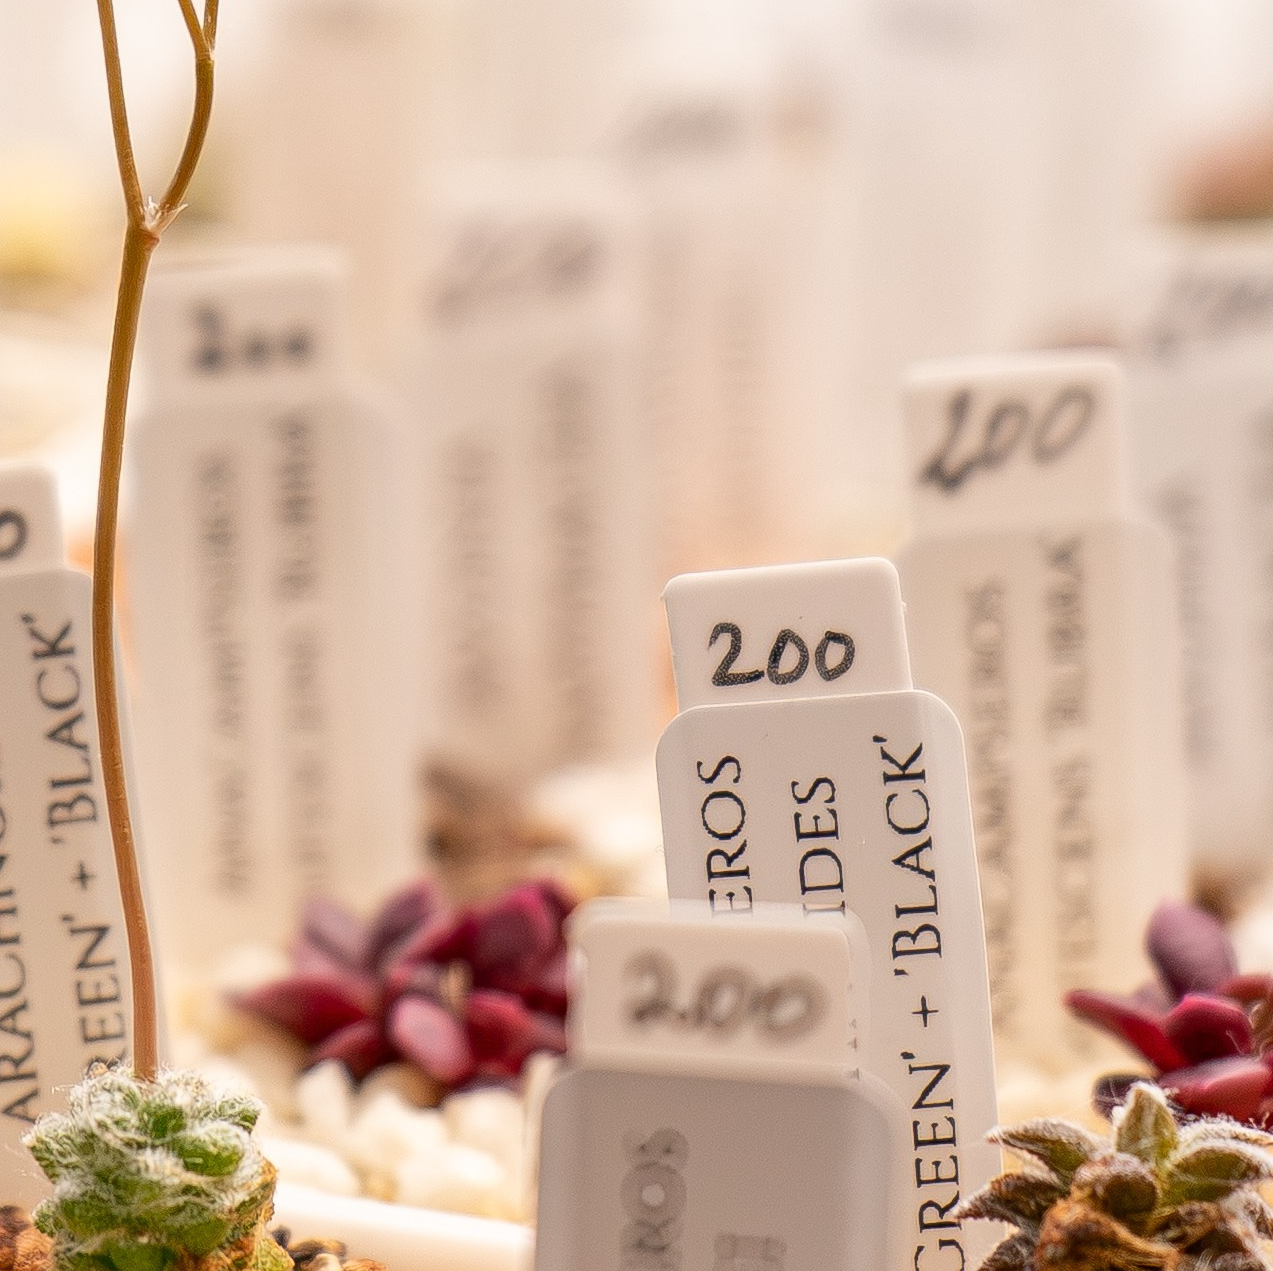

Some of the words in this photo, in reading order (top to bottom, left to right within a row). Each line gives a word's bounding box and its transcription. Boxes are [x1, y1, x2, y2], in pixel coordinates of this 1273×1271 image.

[708, 622, 856, 687] 200
[20, 612, 99, 844] 'BLACK'
[71, 860, 97, 890] +
[872, 735, 942, 976] 'BLACK'
[912, 995, 939, 1028] +
